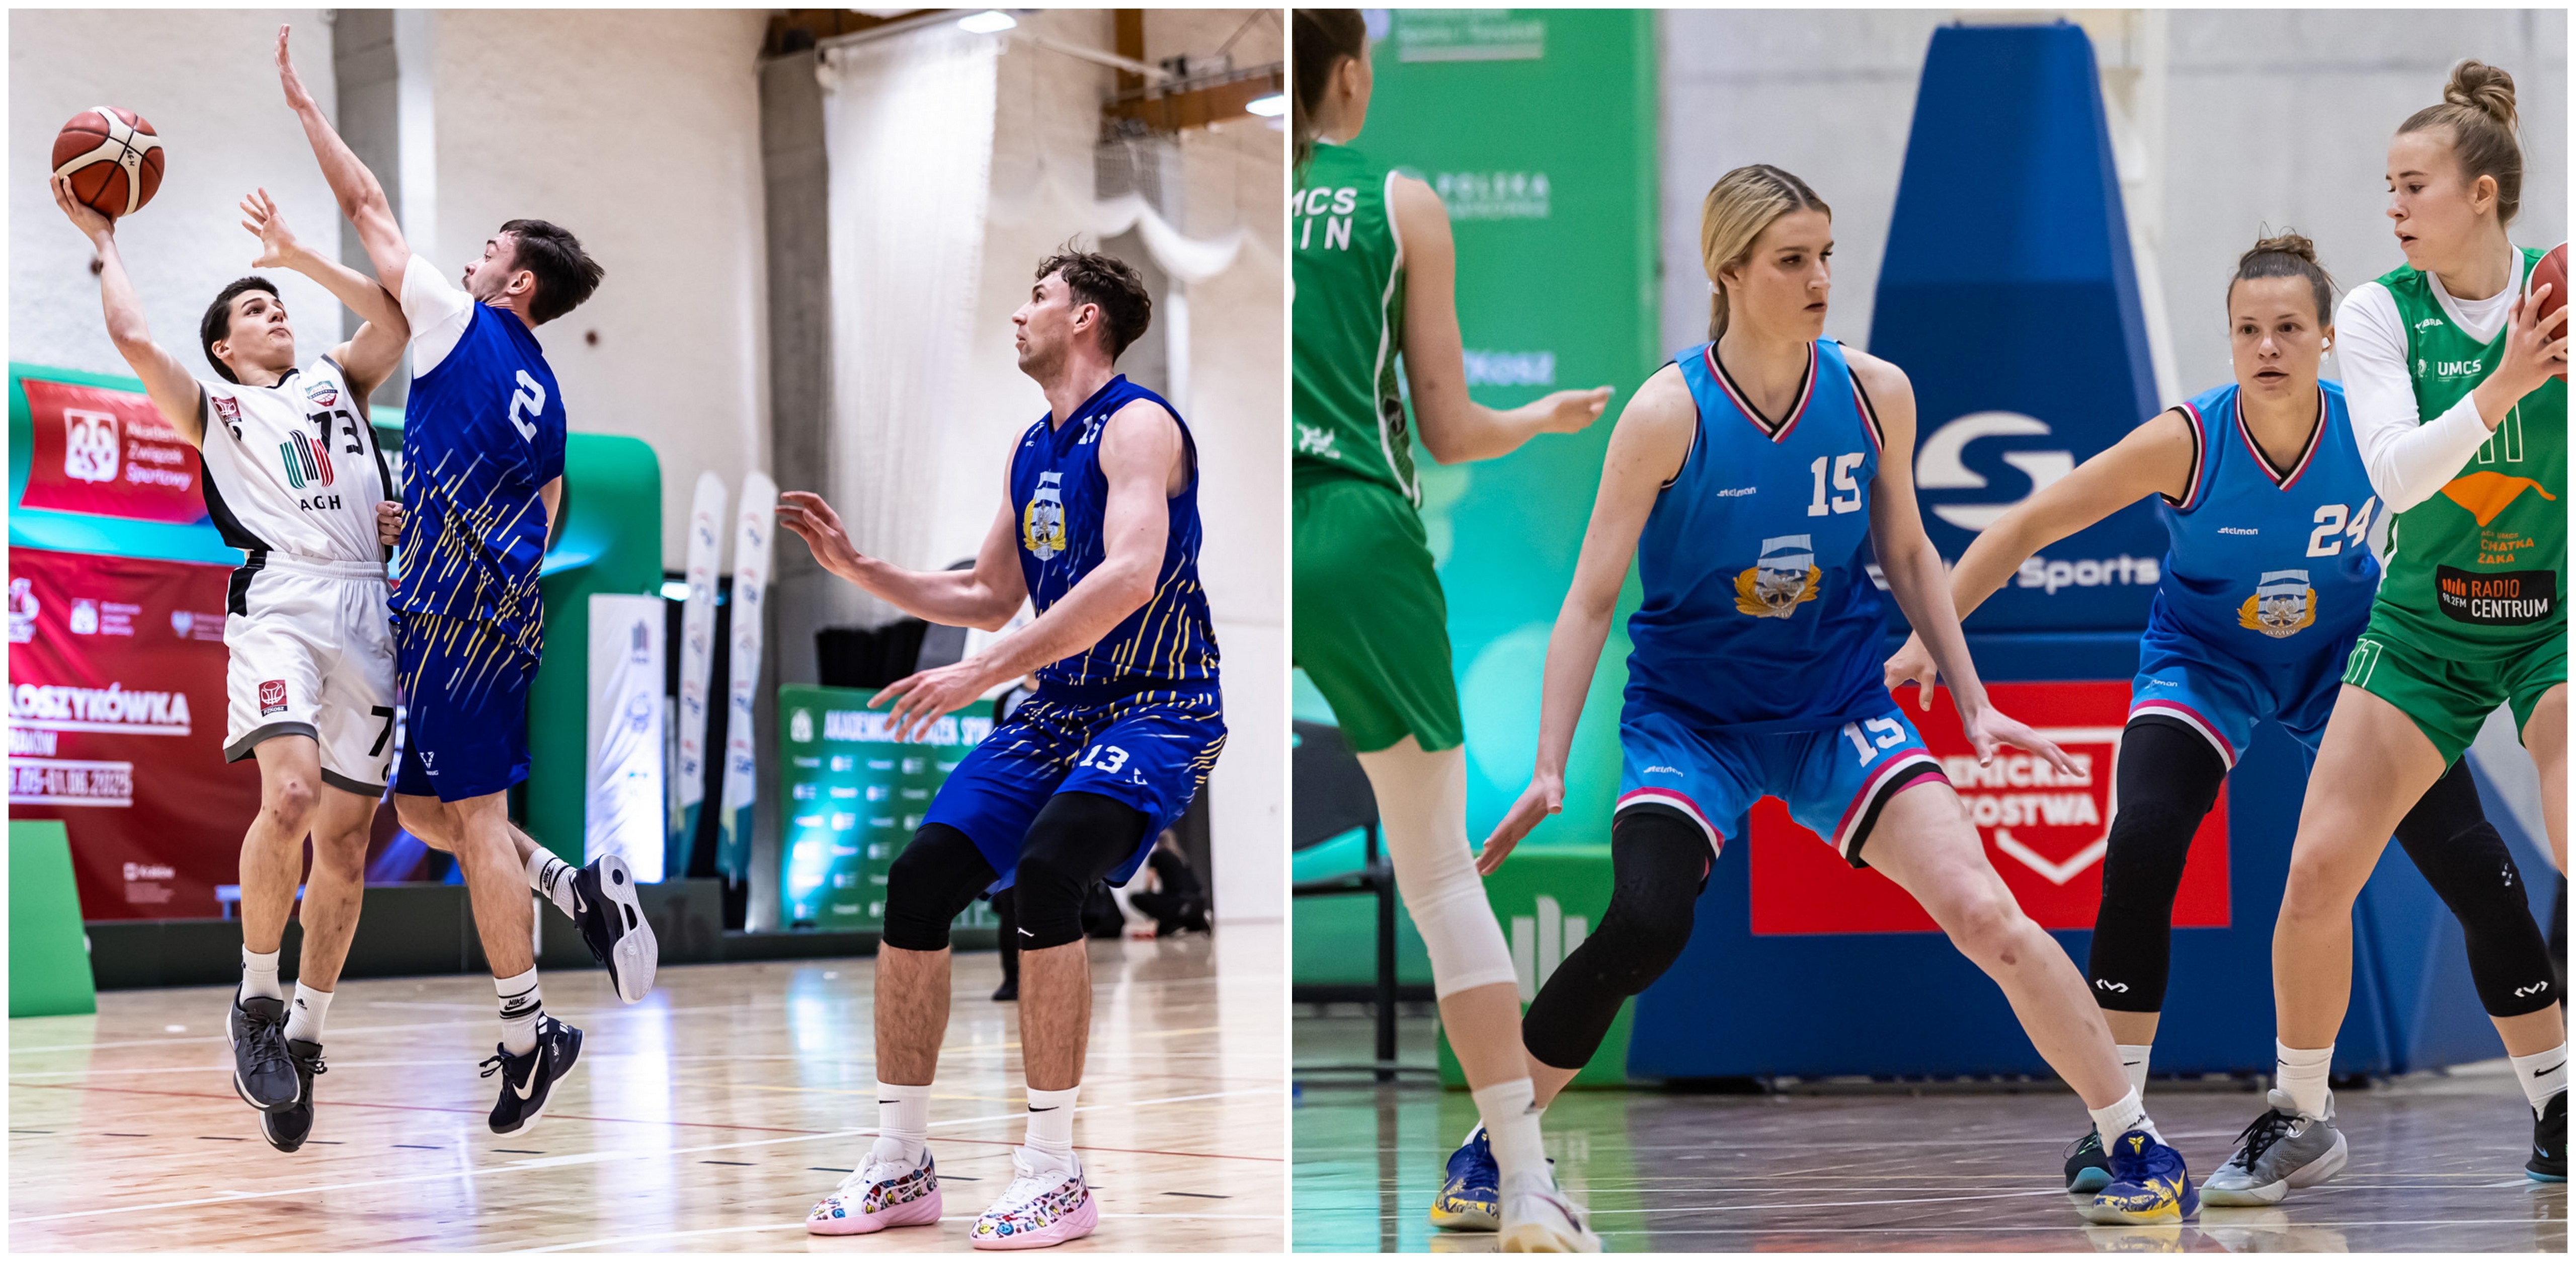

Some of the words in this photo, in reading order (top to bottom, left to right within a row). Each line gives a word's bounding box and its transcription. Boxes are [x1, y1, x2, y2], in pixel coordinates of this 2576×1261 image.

[2438, 359, 2481, 376] UMCS
[508, 369, 546, 444] 2
[306, 410, 364, 456] 73
[1807, 452, 1866, 517] 15
[300, 495, 342, 512] AGH
[2306, 495, 2377, 558] 24
[2481, 537, 2534, 551] CHATKA
[2018, 556, 2160, 595] Sports
[2471, 579, 2520, 598] RADIO
[2471, 598, 2548, 618] CENTRUM
[1843, 717, 1907, 768] 15
[1079, 744, 1130, 774] 13
[508, 996, 526, 1006] NIKE
